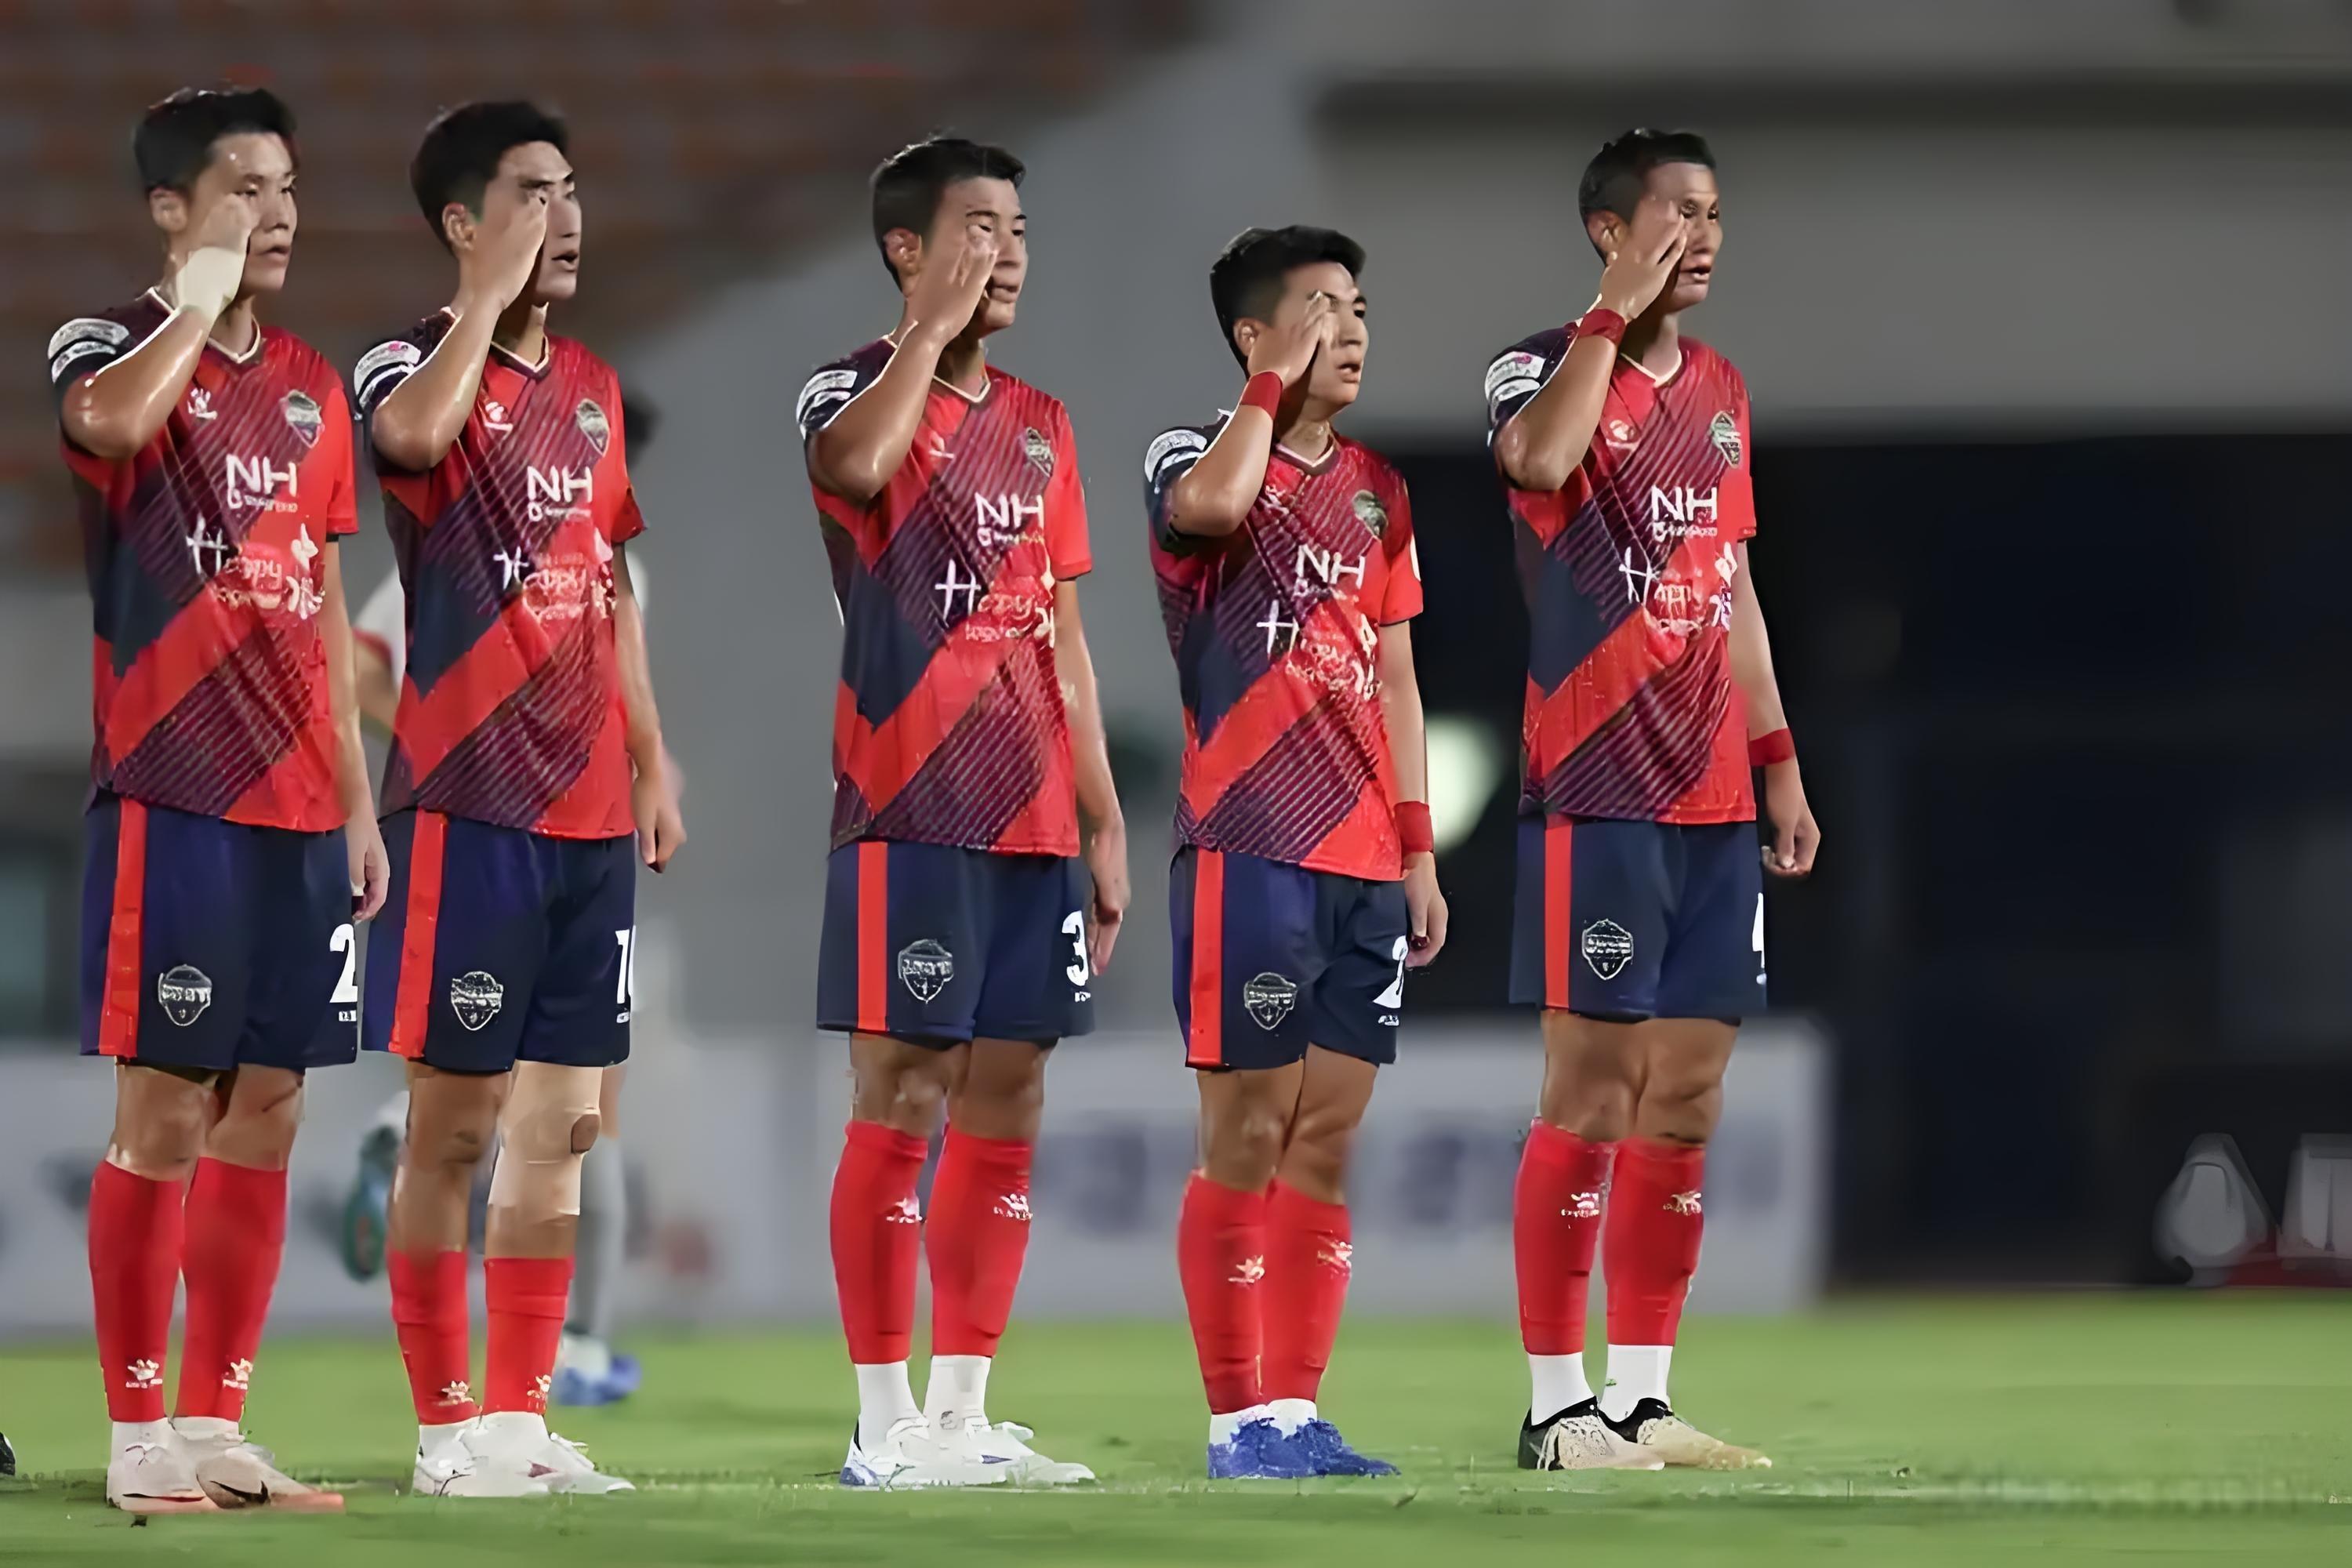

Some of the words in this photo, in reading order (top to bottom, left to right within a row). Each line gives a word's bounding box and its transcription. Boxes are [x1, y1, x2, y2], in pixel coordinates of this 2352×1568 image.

[225, 453, 298, 498] NH
[526, 464, 593, 503] NH
[974, 491, 1044, 530] NH
[1650, 484, 1719, 521] NH
[1295, 543, 1367, 590] NH
[329, 923, 358, 1004] 2
[1061, 909, 1089, 986] 3
